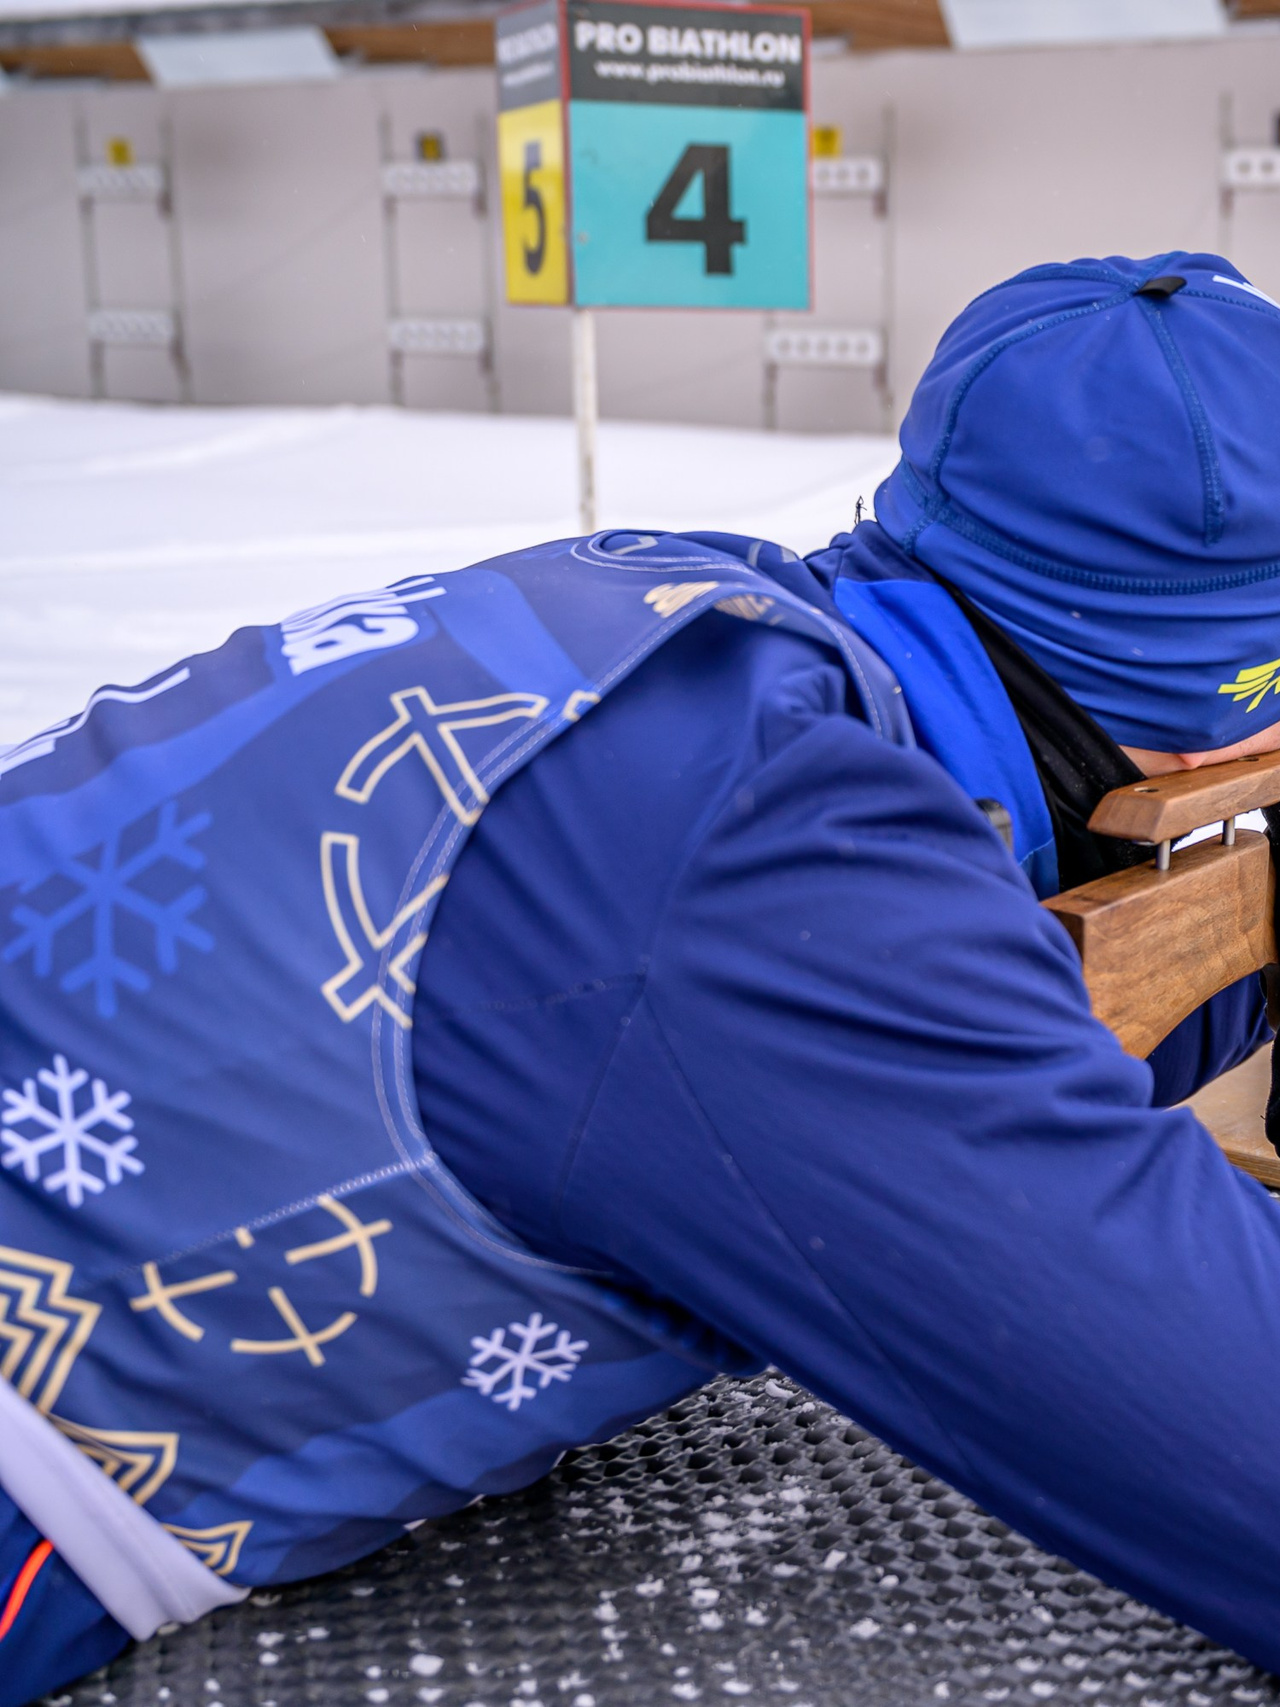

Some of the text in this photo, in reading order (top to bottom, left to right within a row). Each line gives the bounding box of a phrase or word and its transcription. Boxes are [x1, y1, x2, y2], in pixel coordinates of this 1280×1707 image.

[574, 20, 644, 54] PRO
[646, 25, 802, 65] BIATHLON
[523, 139, 547, 277] 5
[644, 142, 747, 277] 4
